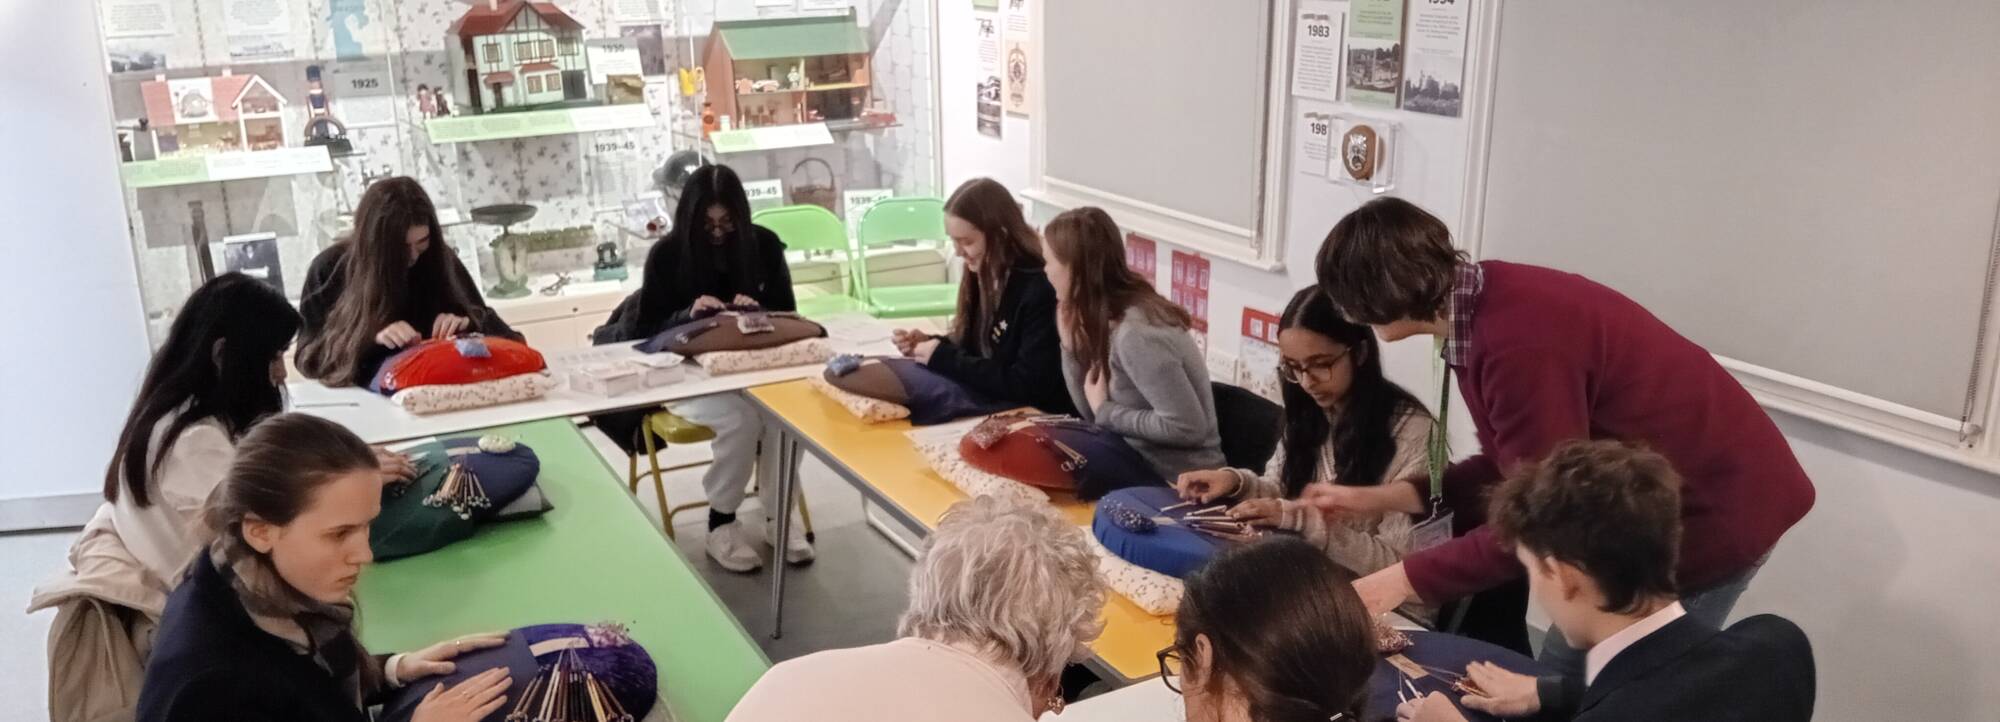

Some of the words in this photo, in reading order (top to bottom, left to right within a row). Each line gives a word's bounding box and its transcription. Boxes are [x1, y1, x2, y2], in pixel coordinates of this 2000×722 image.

[1307, 24, 1330, 38] 1983
[351, 78, 379, 89] 1925
[1310, 122, 1329, 136] 198
